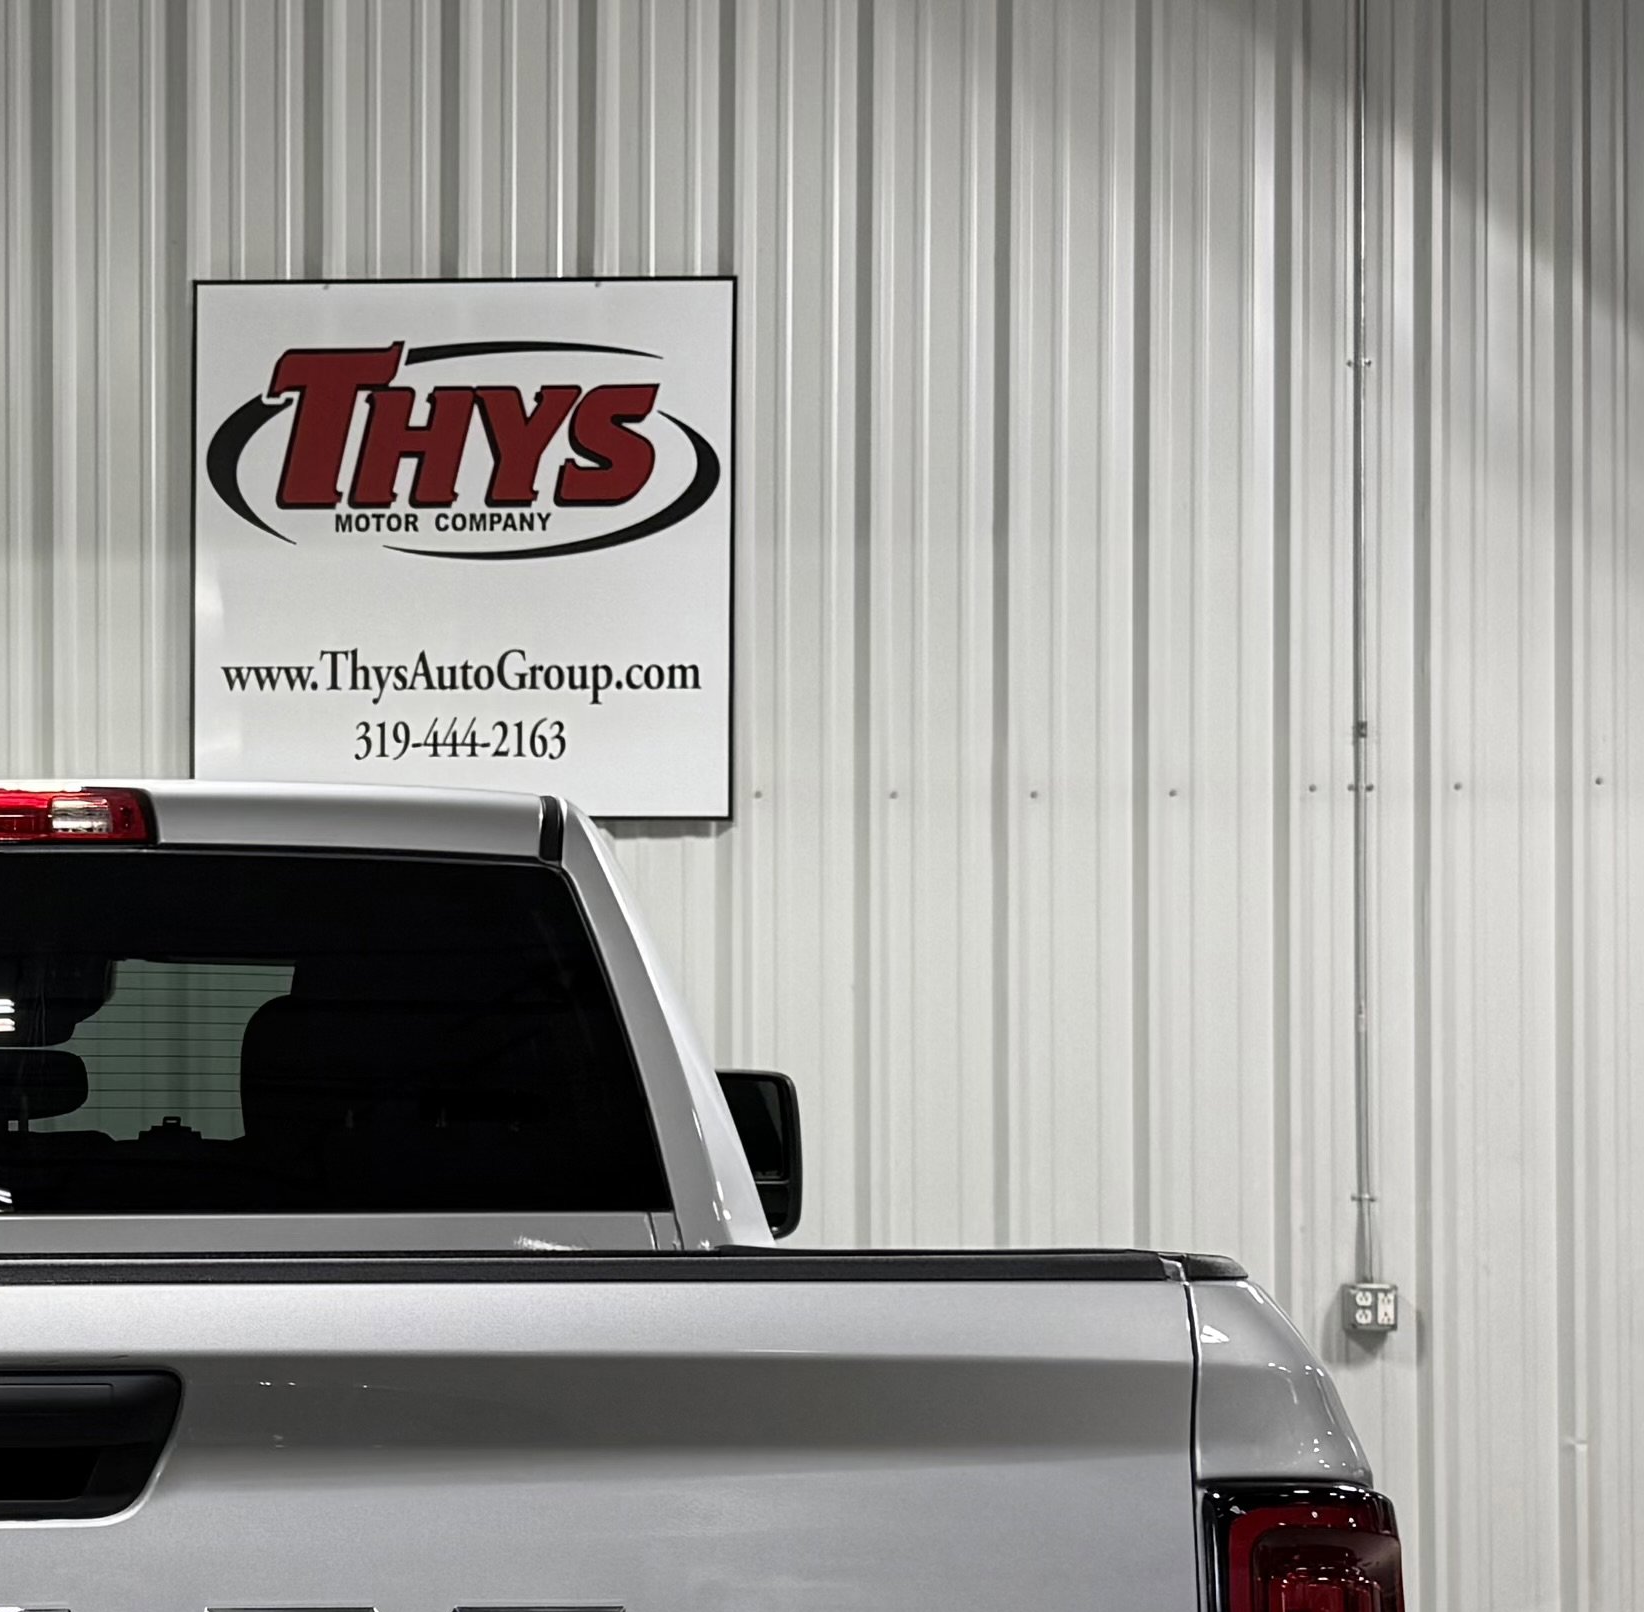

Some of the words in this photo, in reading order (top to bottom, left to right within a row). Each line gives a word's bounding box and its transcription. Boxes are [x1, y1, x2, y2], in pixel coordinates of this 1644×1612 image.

[267, 341, 660, 510] THYS
[334, 513, 419, 533] MOTOR
[435, 512, 552, 532] COMPANY
[221, 648, 702, 704] www.ThysAutoGroup.com
[354, 717, 567, 761] 319-444-2163
